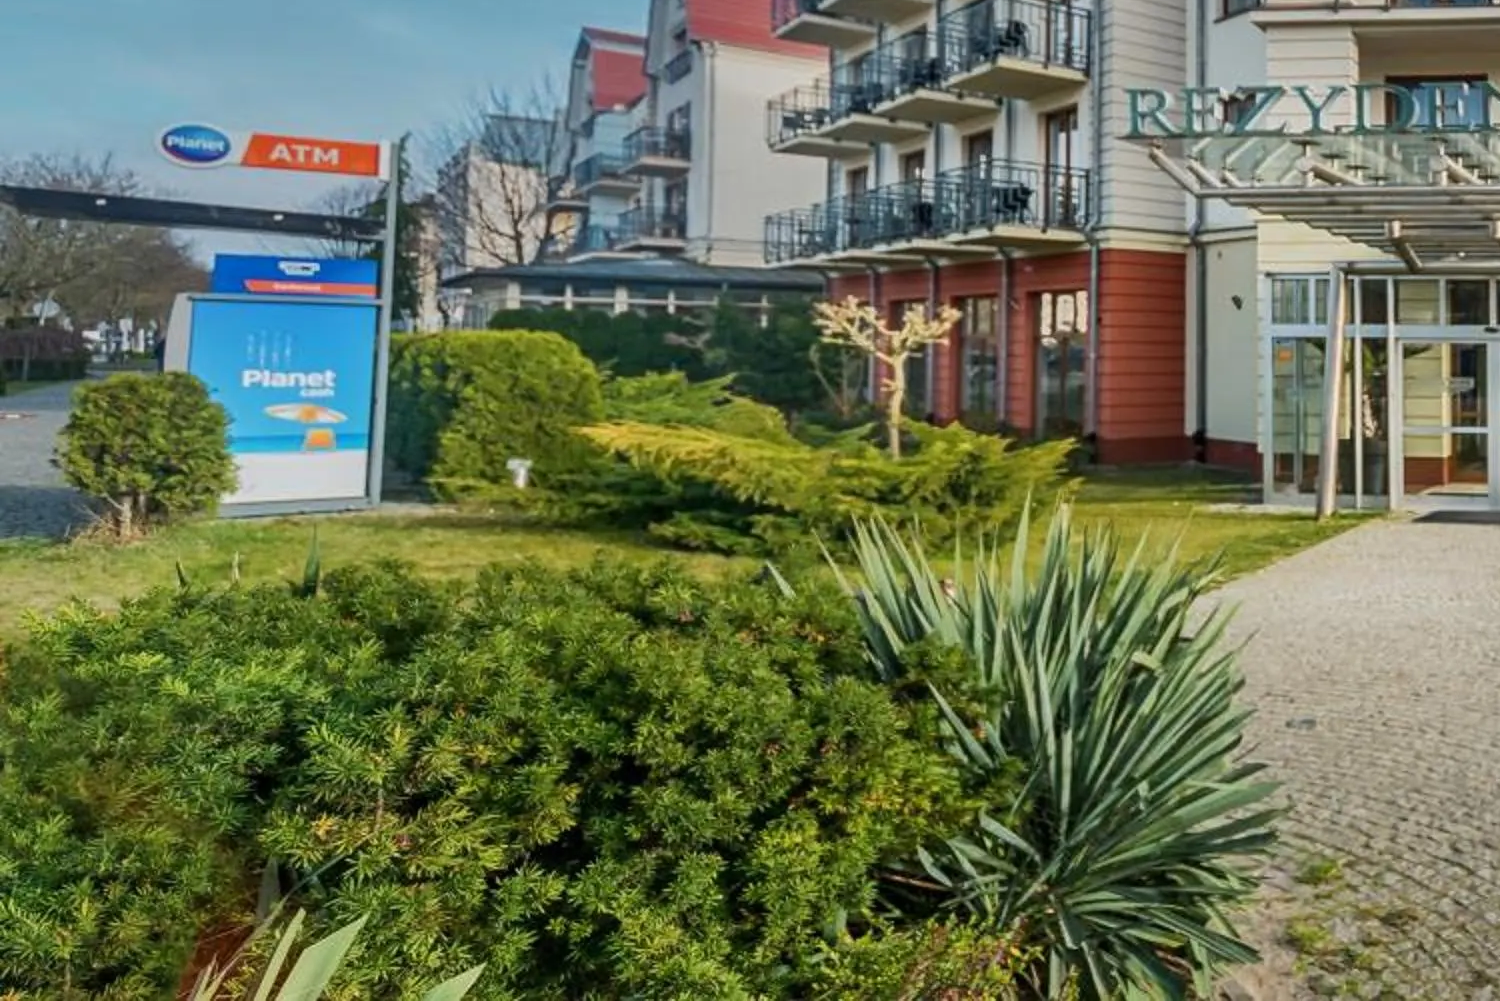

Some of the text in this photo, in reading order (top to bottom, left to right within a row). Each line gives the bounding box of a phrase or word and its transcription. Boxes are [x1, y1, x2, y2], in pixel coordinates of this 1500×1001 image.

[167, 134, 225, 152] Planet
[269, 143, 340, 166] ATM
[242, 368, 337, 388] Planet
